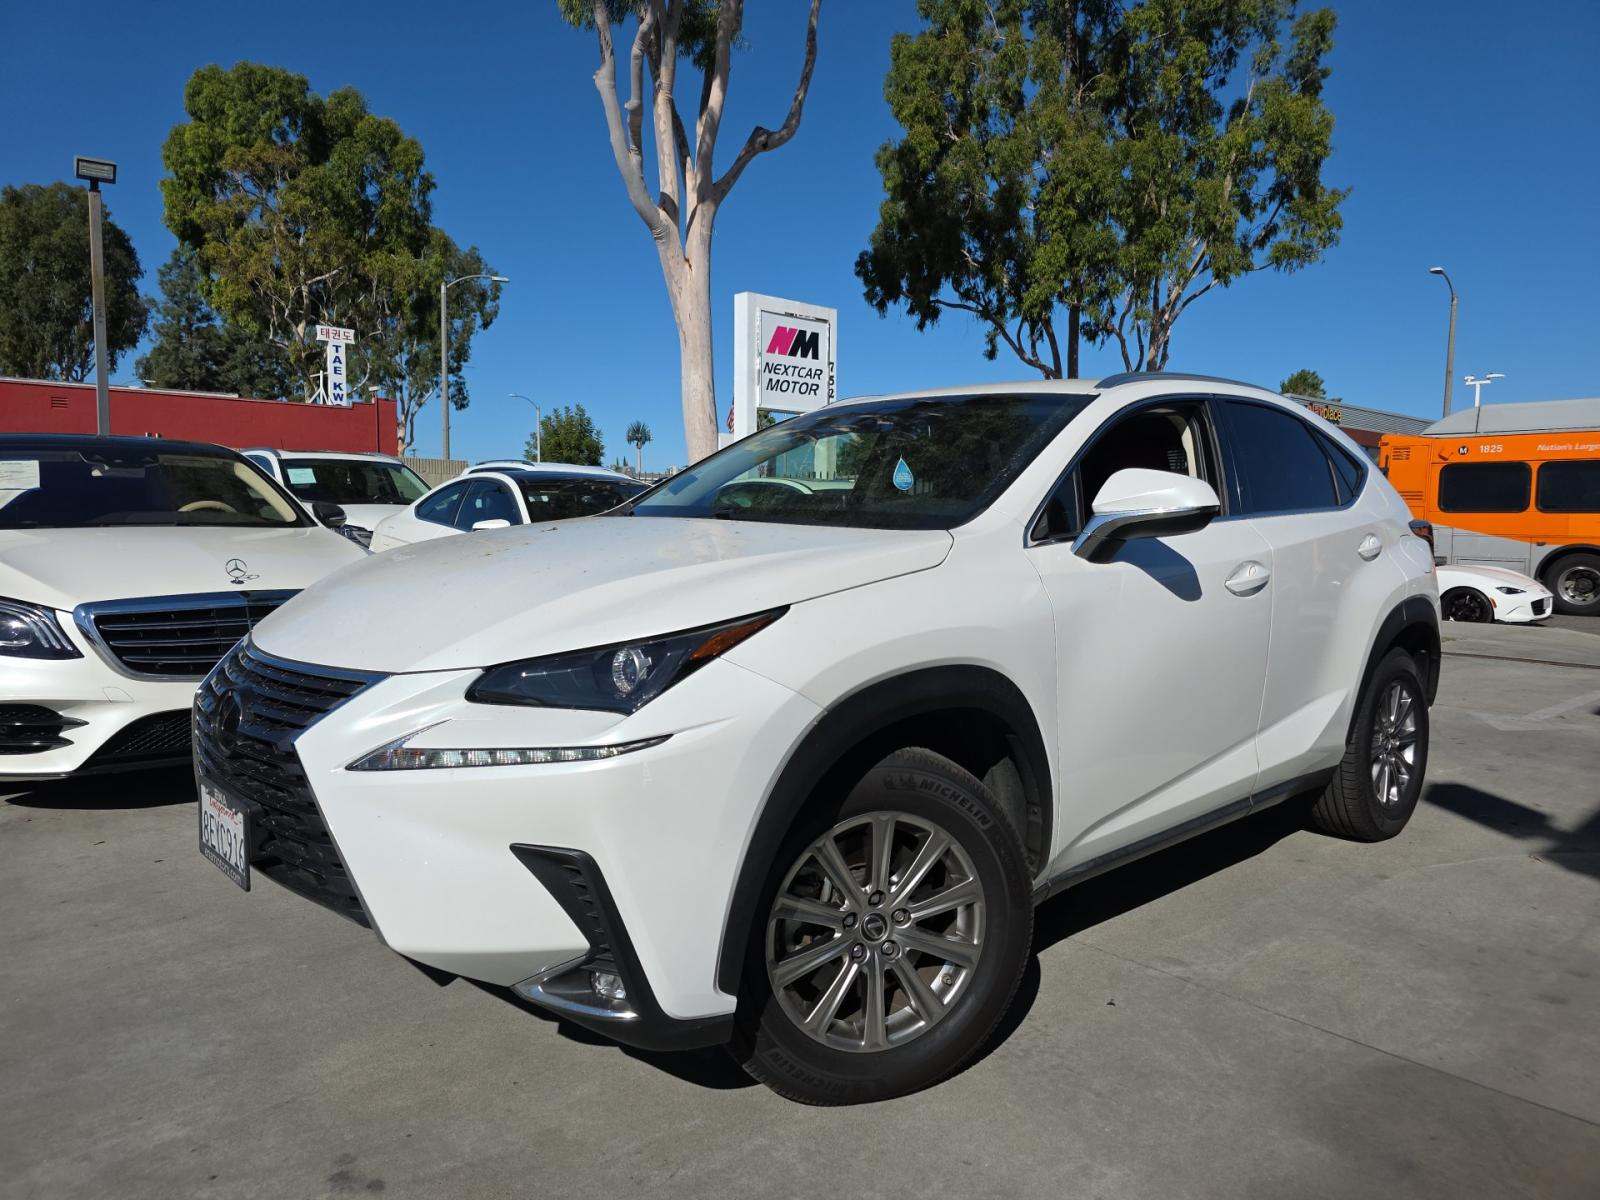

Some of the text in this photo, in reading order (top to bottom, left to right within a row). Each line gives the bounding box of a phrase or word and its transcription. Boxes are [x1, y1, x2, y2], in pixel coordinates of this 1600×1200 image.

[320, 328, 352, 340] 태권도
[332, 344, 344, 406] TAE KW
[763, 362, 823, 380] NEXTCAR
[766, 378, 819, 396] MOTOR
[1480, 444, 1503, 453] 1825
[920, 778, 991, 828] MICHELIN
[203, 810, 245, 874] 8EYC916
